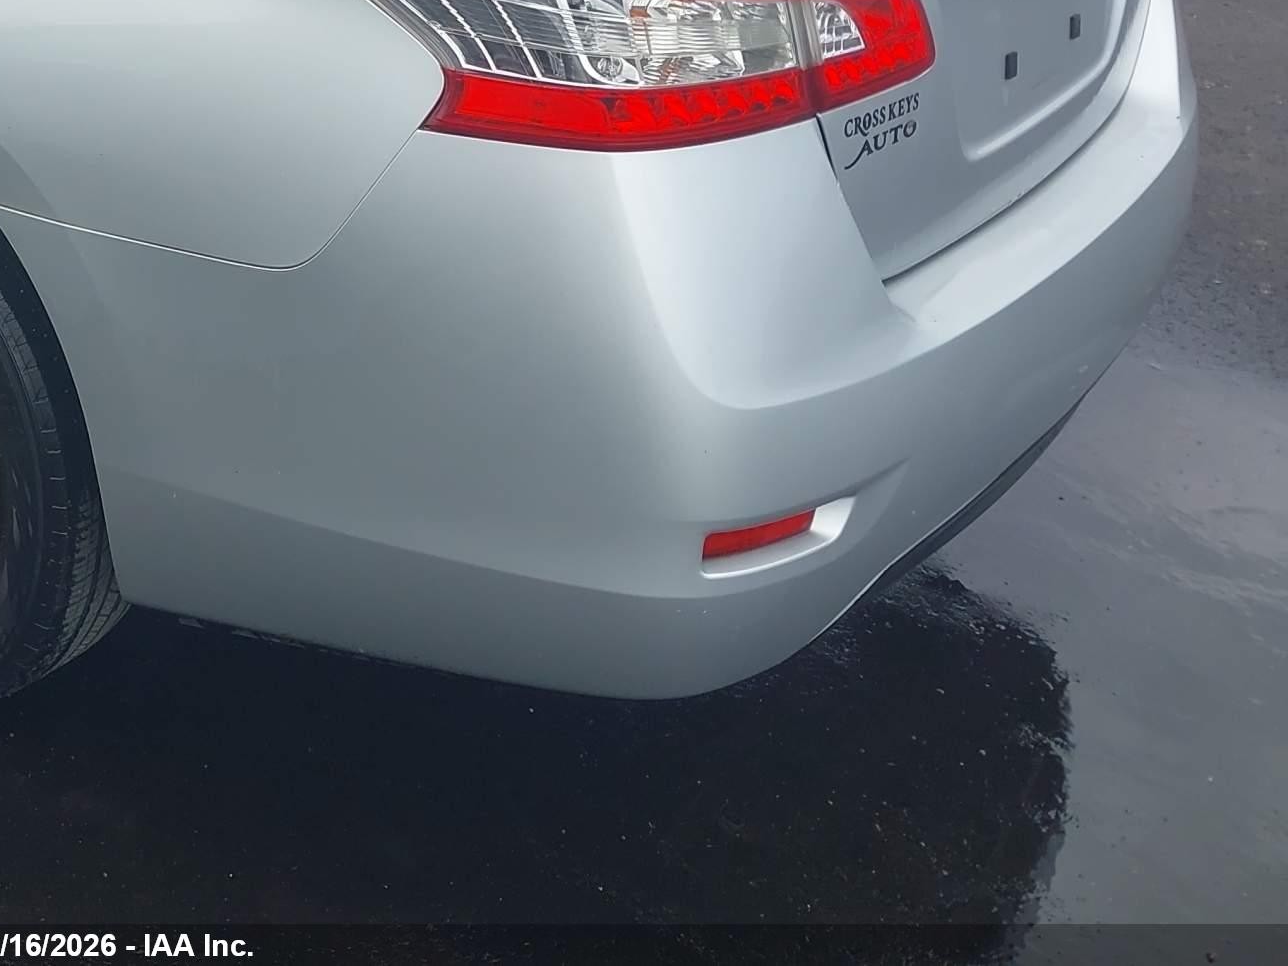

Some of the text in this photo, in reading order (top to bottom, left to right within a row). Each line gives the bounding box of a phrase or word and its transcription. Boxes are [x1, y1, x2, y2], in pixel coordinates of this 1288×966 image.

[844, 92, 920, 138] CROSS KEYS
[844, 120, 917, 170] AUTO
